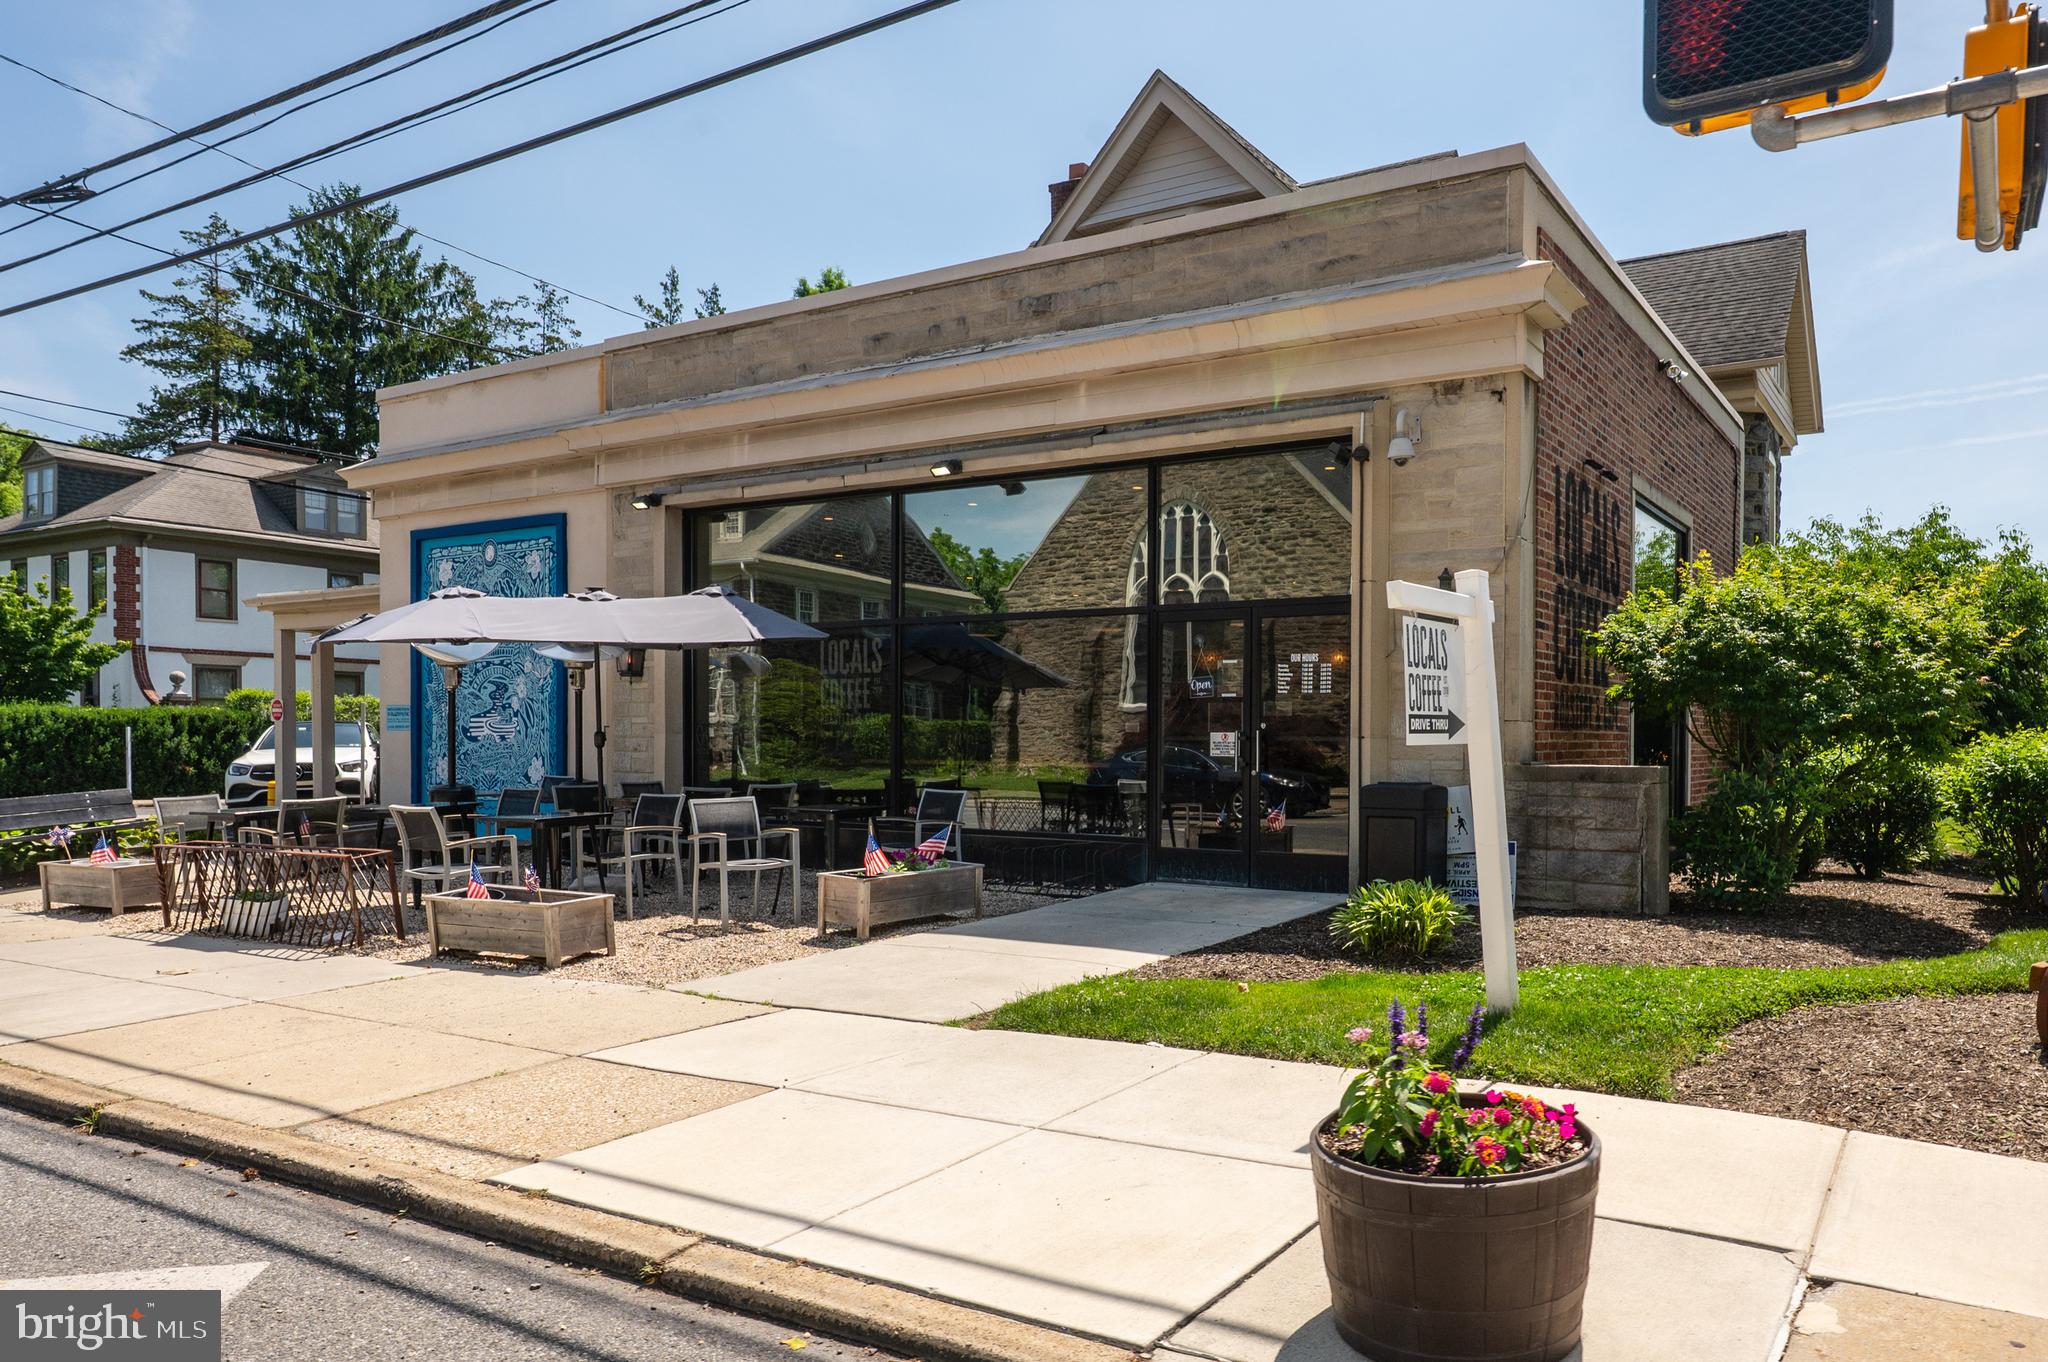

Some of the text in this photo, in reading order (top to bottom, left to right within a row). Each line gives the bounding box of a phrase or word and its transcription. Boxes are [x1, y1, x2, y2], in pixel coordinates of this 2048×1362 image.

[1555, 465, 1620, 597] LOCALS
[821, 637, 883, 675] LOCALS
[1406, 623, 1448, 671] LOCALS
[821, 677, 872, 710] COFFEE
[1190, 679, 1212, 693] Open
[1408, 672, 1443, 712] COFFEE
[1410, 718, 1449, 731] DRIVE THRU
[1451, 889, 1479, 898] NSIDE
